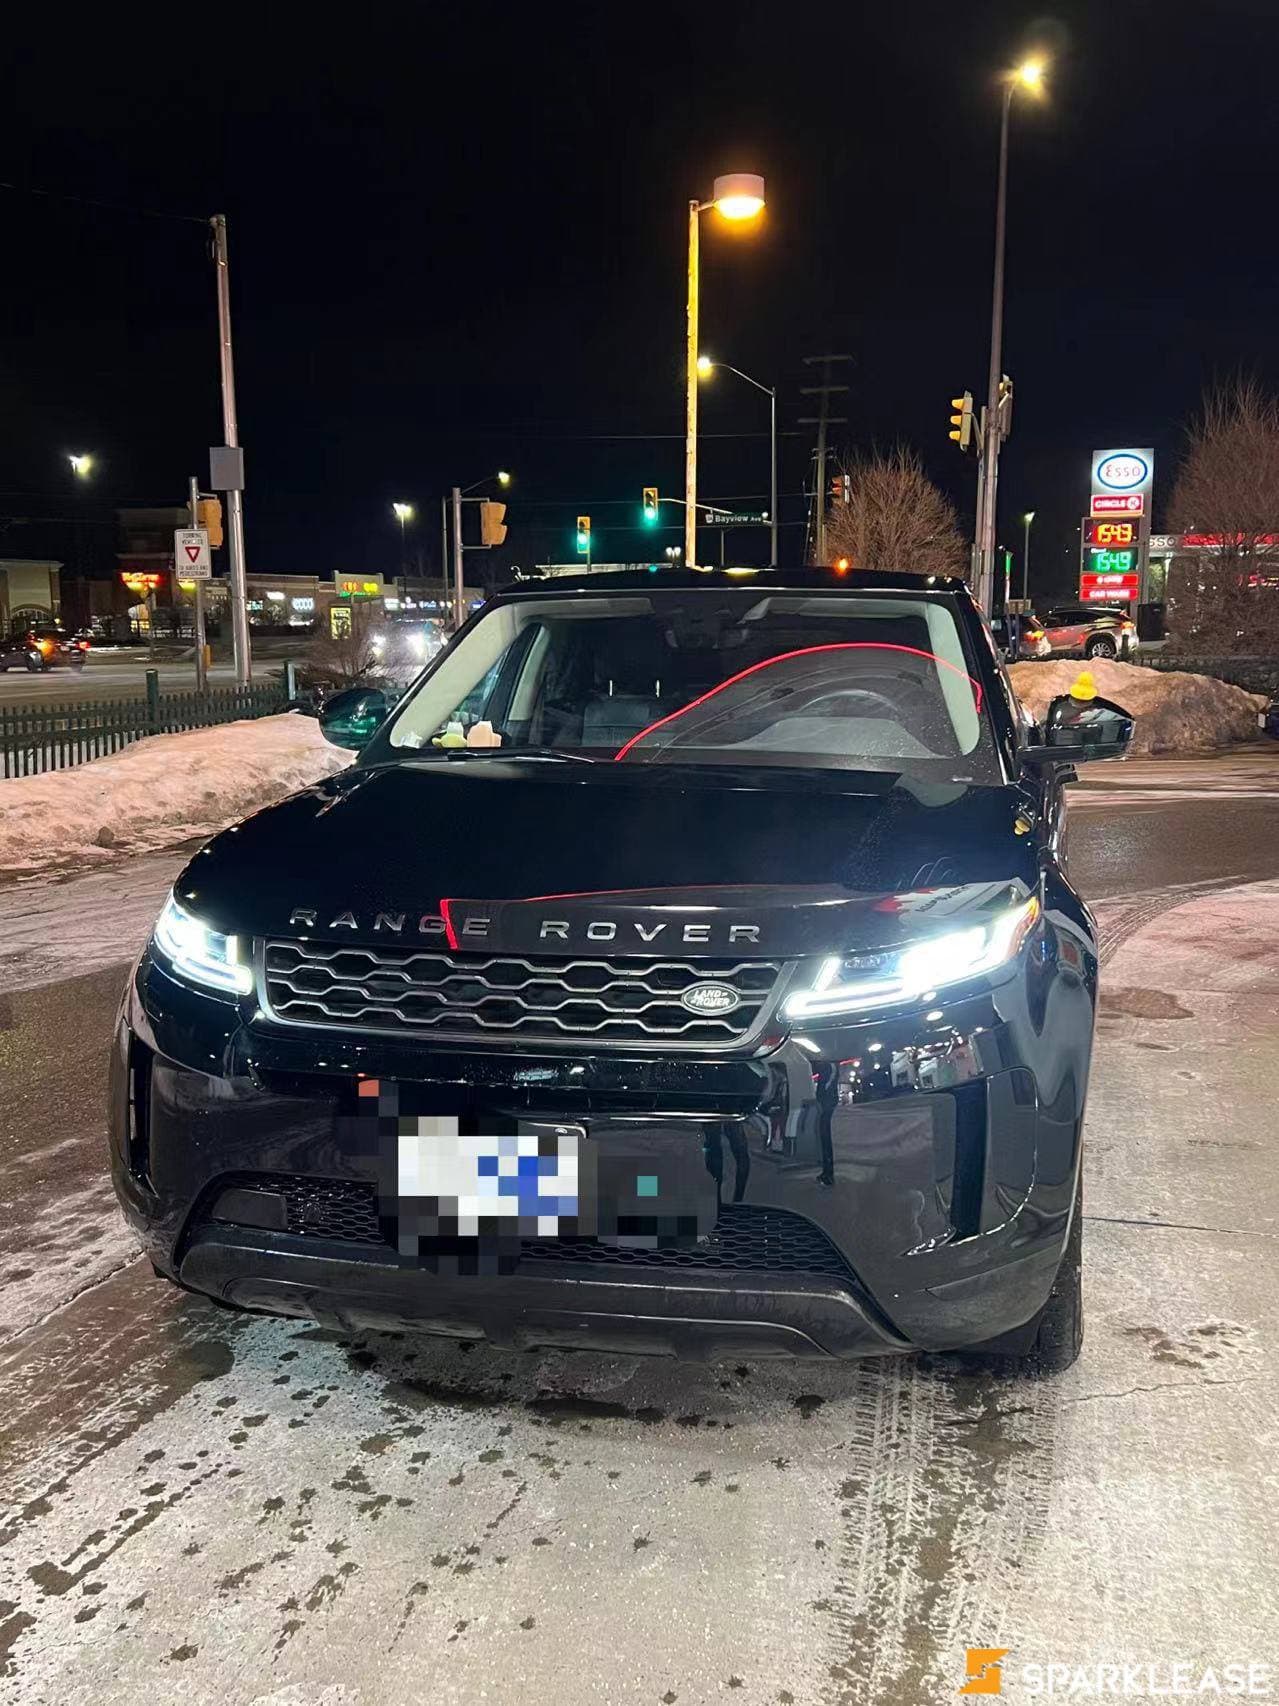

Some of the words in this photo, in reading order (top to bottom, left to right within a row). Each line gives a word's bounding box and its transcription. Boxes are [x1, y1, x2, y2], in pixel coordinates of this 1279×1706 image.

[1095, 499, 1126, 509] CIRCLE
[715, 515, 748, 524] Bayview
[289, 907, 491, 936] RANGE
[540, 920, 760, 944] ROVER
[694, 989, 721, 998] LAND
[696, 997, 730, 1007] ROVER
